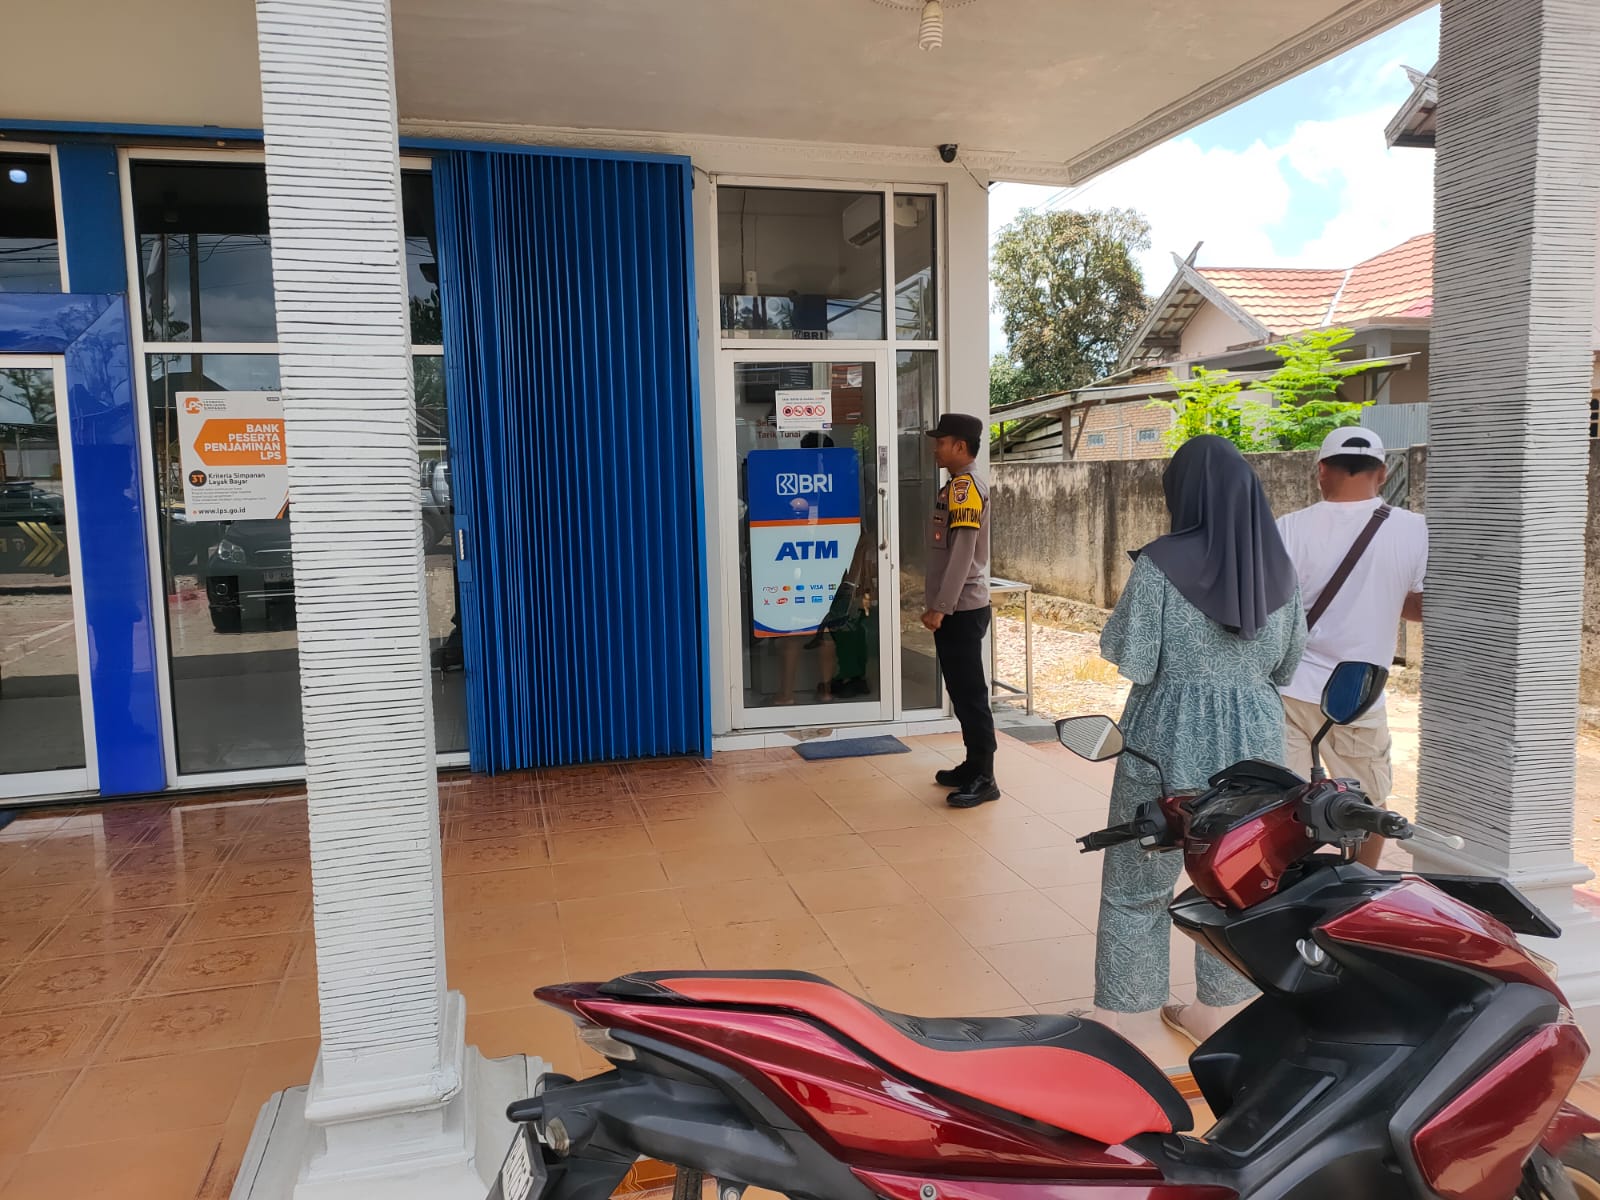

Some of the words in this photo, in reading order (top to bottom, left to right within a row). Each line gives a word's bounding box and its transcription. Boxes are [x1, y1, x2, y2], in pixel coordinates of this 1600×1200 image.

[246, 423, 280, 433] BANK
[228, 433, 281, 442] PESERTA
[204, 442, 281, 452] PENJAMINAN
[260, 451, 281, 460] LPS
[233, 472, 266, 480] Simpanan
[799, 473, 833, 493] BRI
[198, 507, 246, 515] www.lps.go.id
[775, 540, 838, 561] ATM
